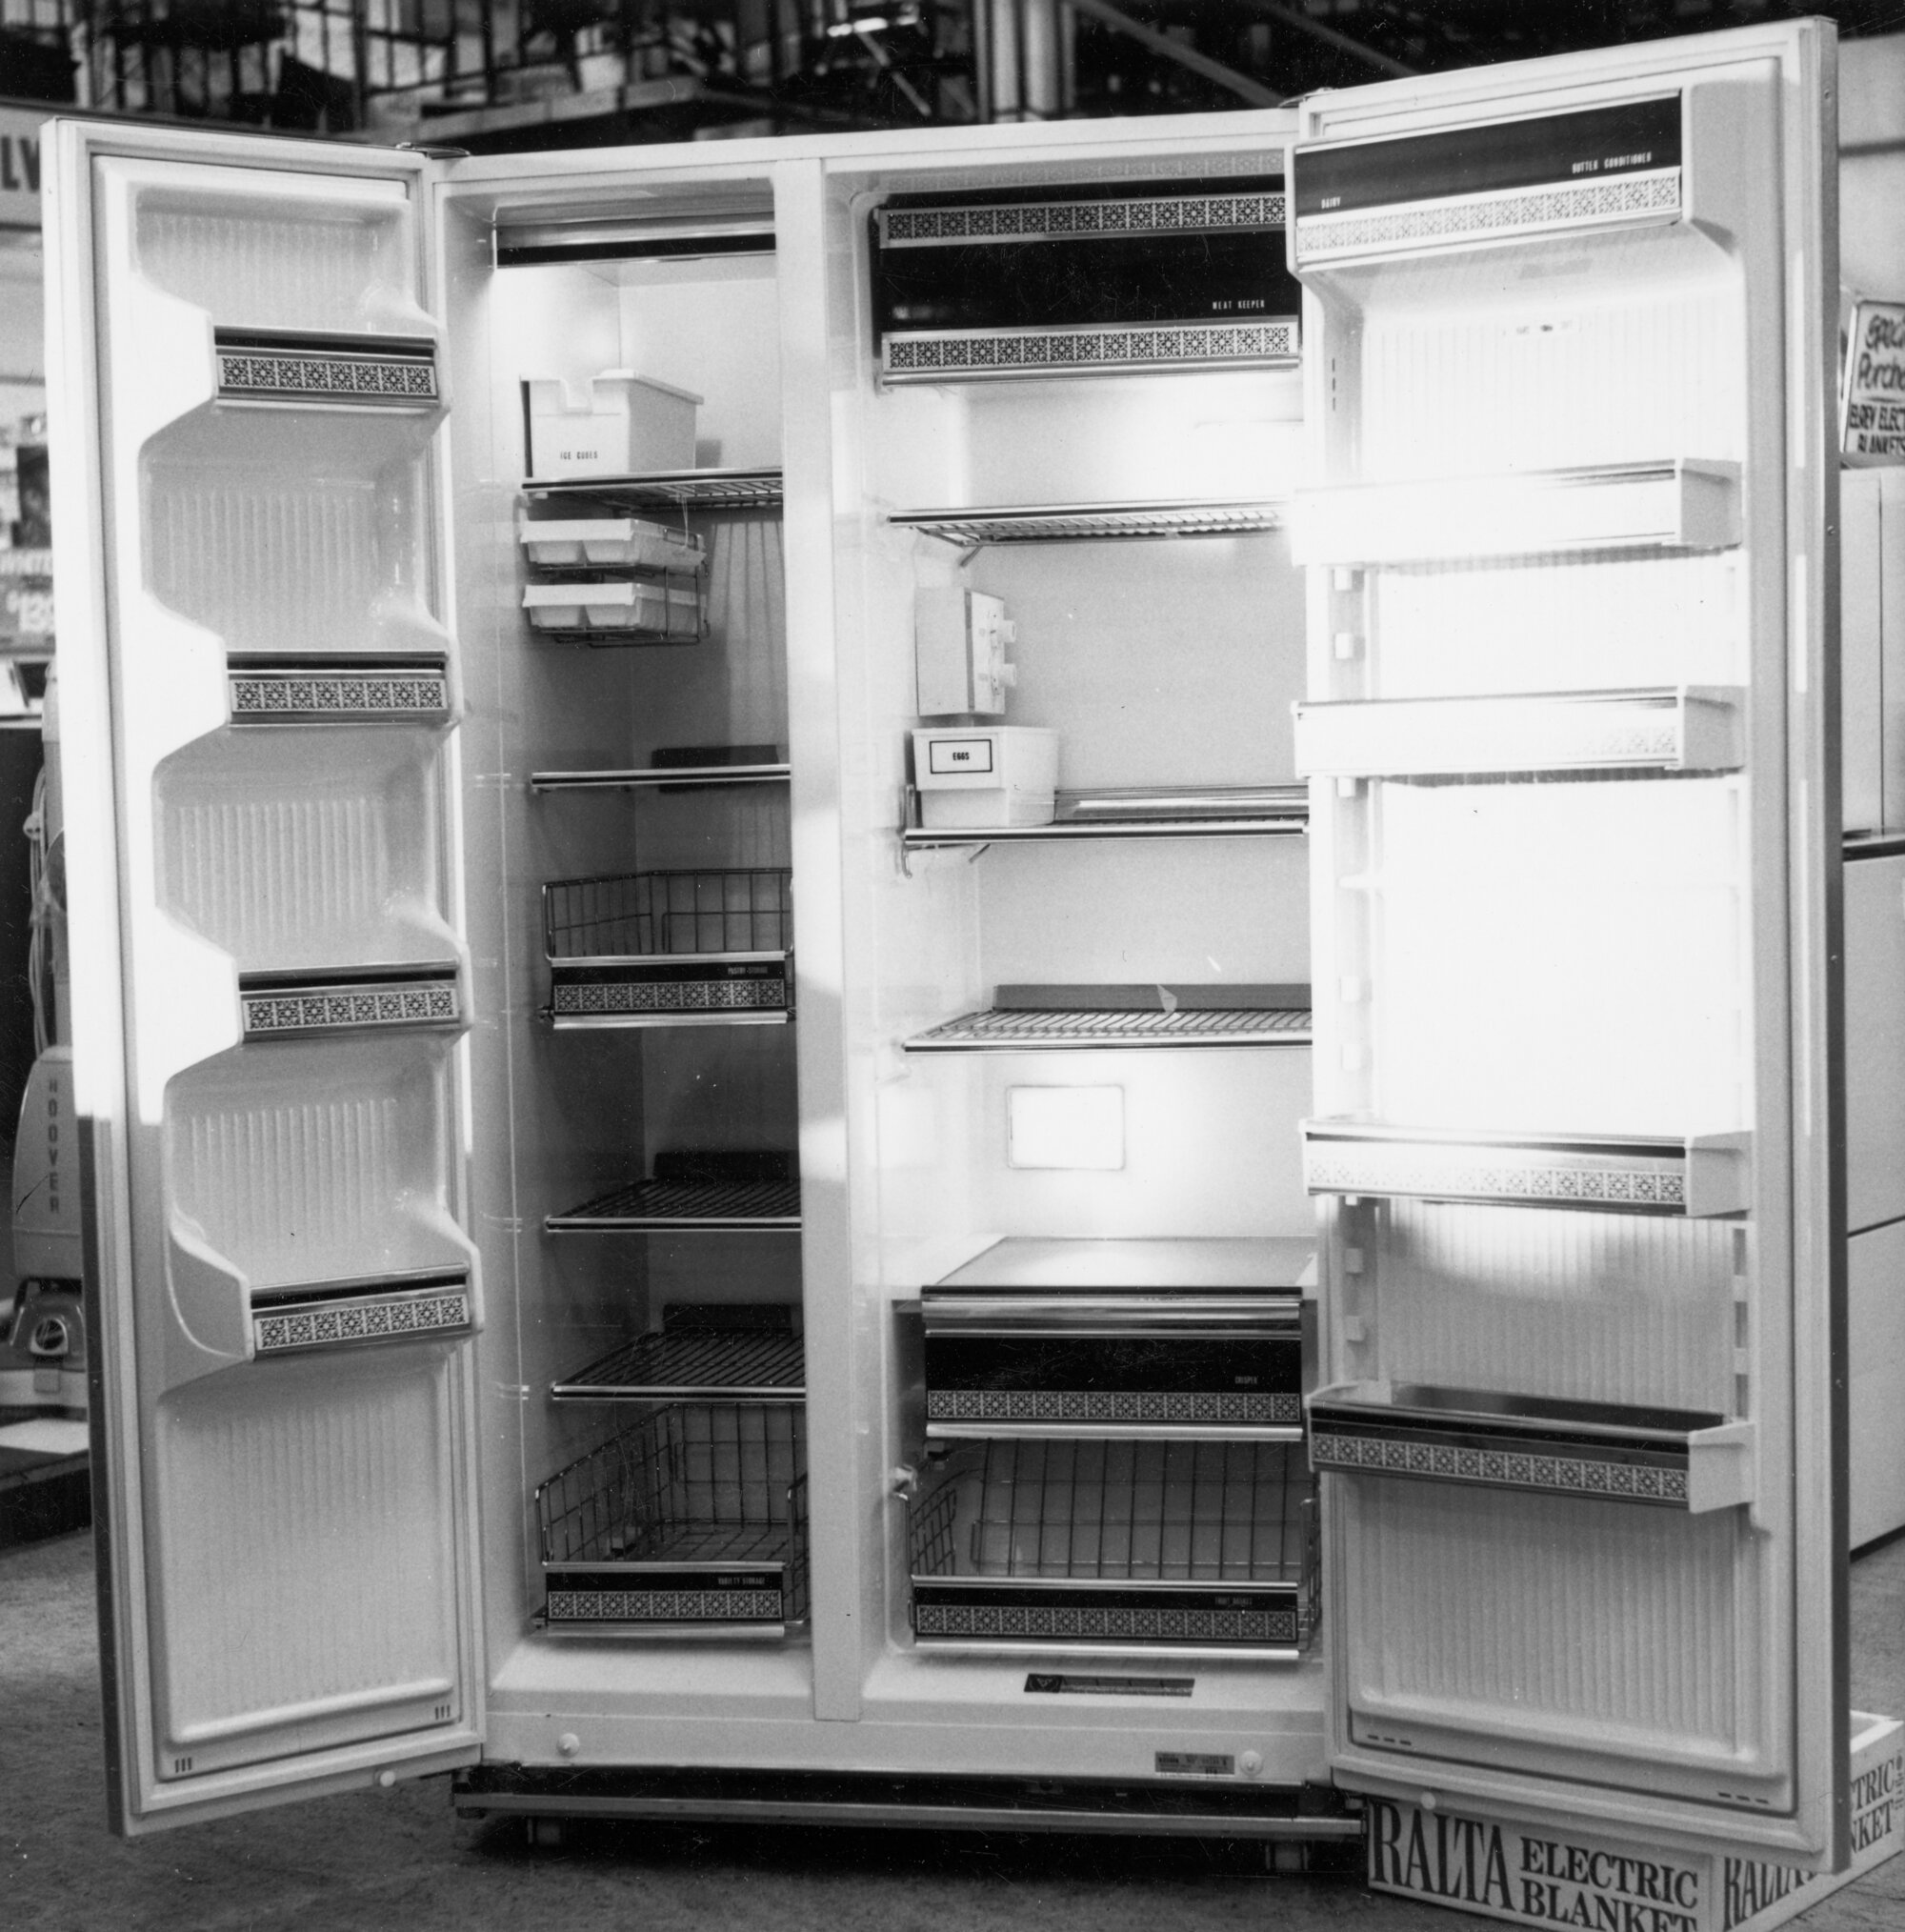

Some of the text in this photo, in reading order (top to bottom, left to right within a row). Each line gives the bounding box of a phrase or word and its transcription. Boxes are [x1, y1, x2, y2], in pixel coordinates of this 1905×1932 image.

[1213, 299, 1265, 310] MEAT KEEPER
[560, 451, 572, 460] ICE
[952, 752, 970, 761] EGGS
[48, 1078, 60, 1215] HOOVER
[1850, 1758, 1895, 1810] TRIC
[1372, 1797, 1698, 1912] RALTA ELECTRIC
